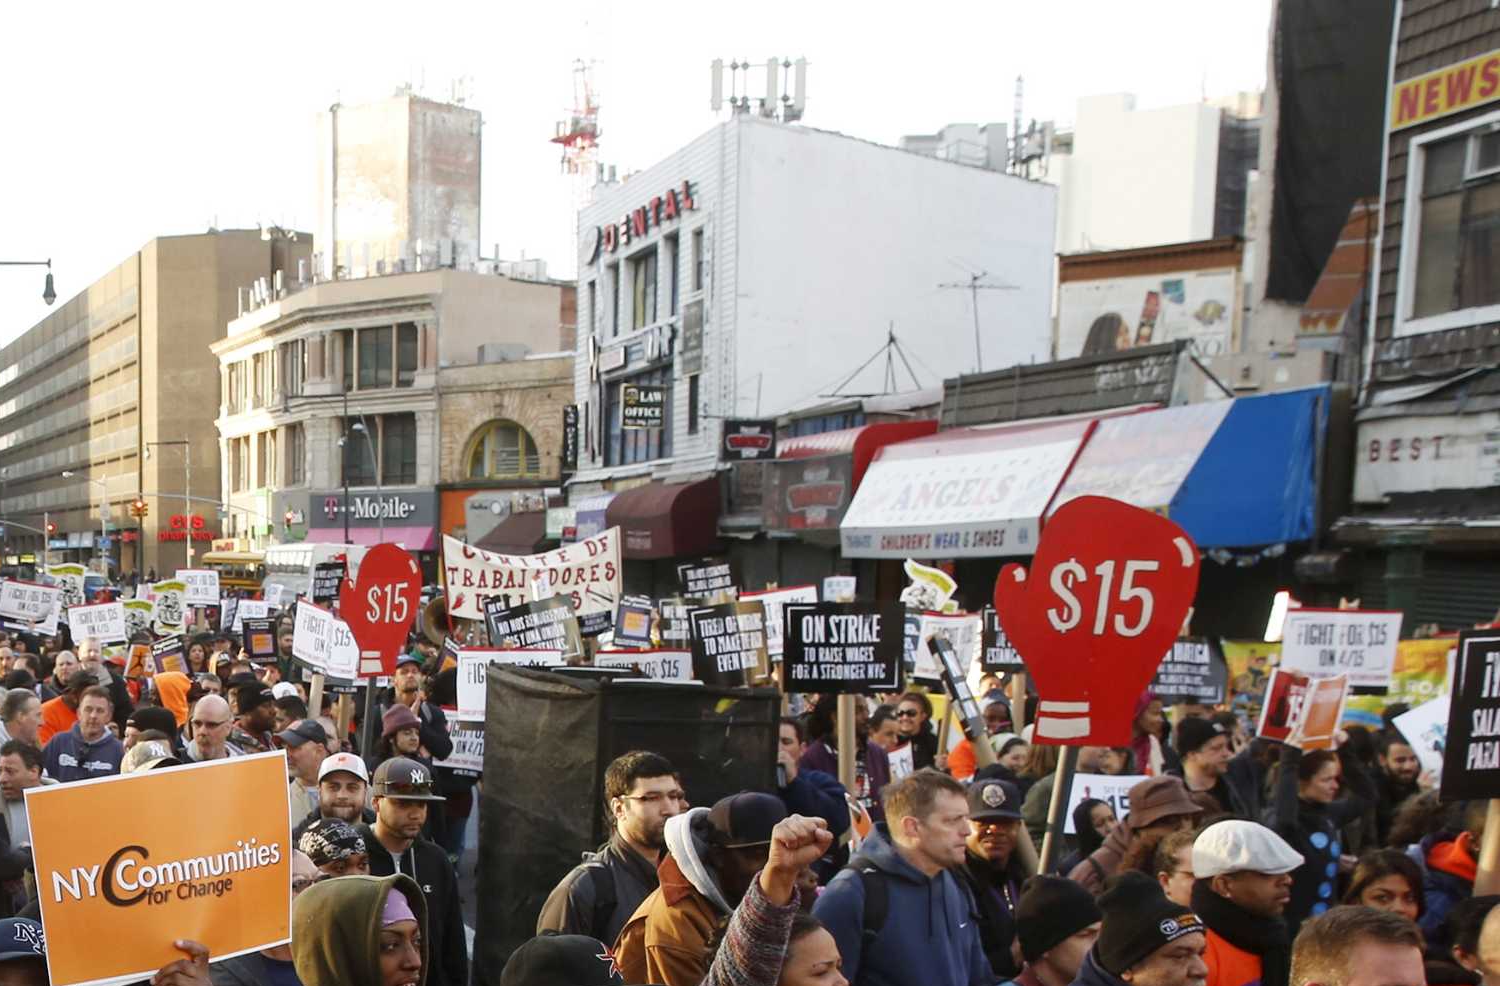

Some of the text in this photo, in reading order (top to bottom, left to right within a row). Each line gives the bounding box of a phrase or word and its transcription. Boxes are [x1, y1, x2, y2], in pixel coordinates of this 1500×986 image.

[1397, 57, 1500, 124] NEWS
[604, 181, 693, 253] DENTAL
[640, 391, 663, 401] LAW
[625, 408, 662, 417] OFFICE
[170, 515, 205, 528] CVS
[934, 531, 960, 550] WEAR
[973, 529, 1005, 548] SHOES
[366, 582, 409, 624] $15
[1047, 557, 1160, 638] $15
[802, 614, 881, 644] ON STRIKE
[1368, 621, 1389, 647] $15
[803, 646, 875, 662] TO RAISE WAGES
[1319, 649, 1365, 667] ON 4/15
[467, 662, 486, 684] FIG
[645, 658, 679, 680] OR $15
[792, 663, 887, 680] FOR A STRONGER NYC
[149, 742, 166, 757] NY
[468, 741, 484, 757] 4/1
[410, 769, 424, 783] NY
[53, 838, 281, 907] NY Communities
[147, 875, 234, 906] for Change
